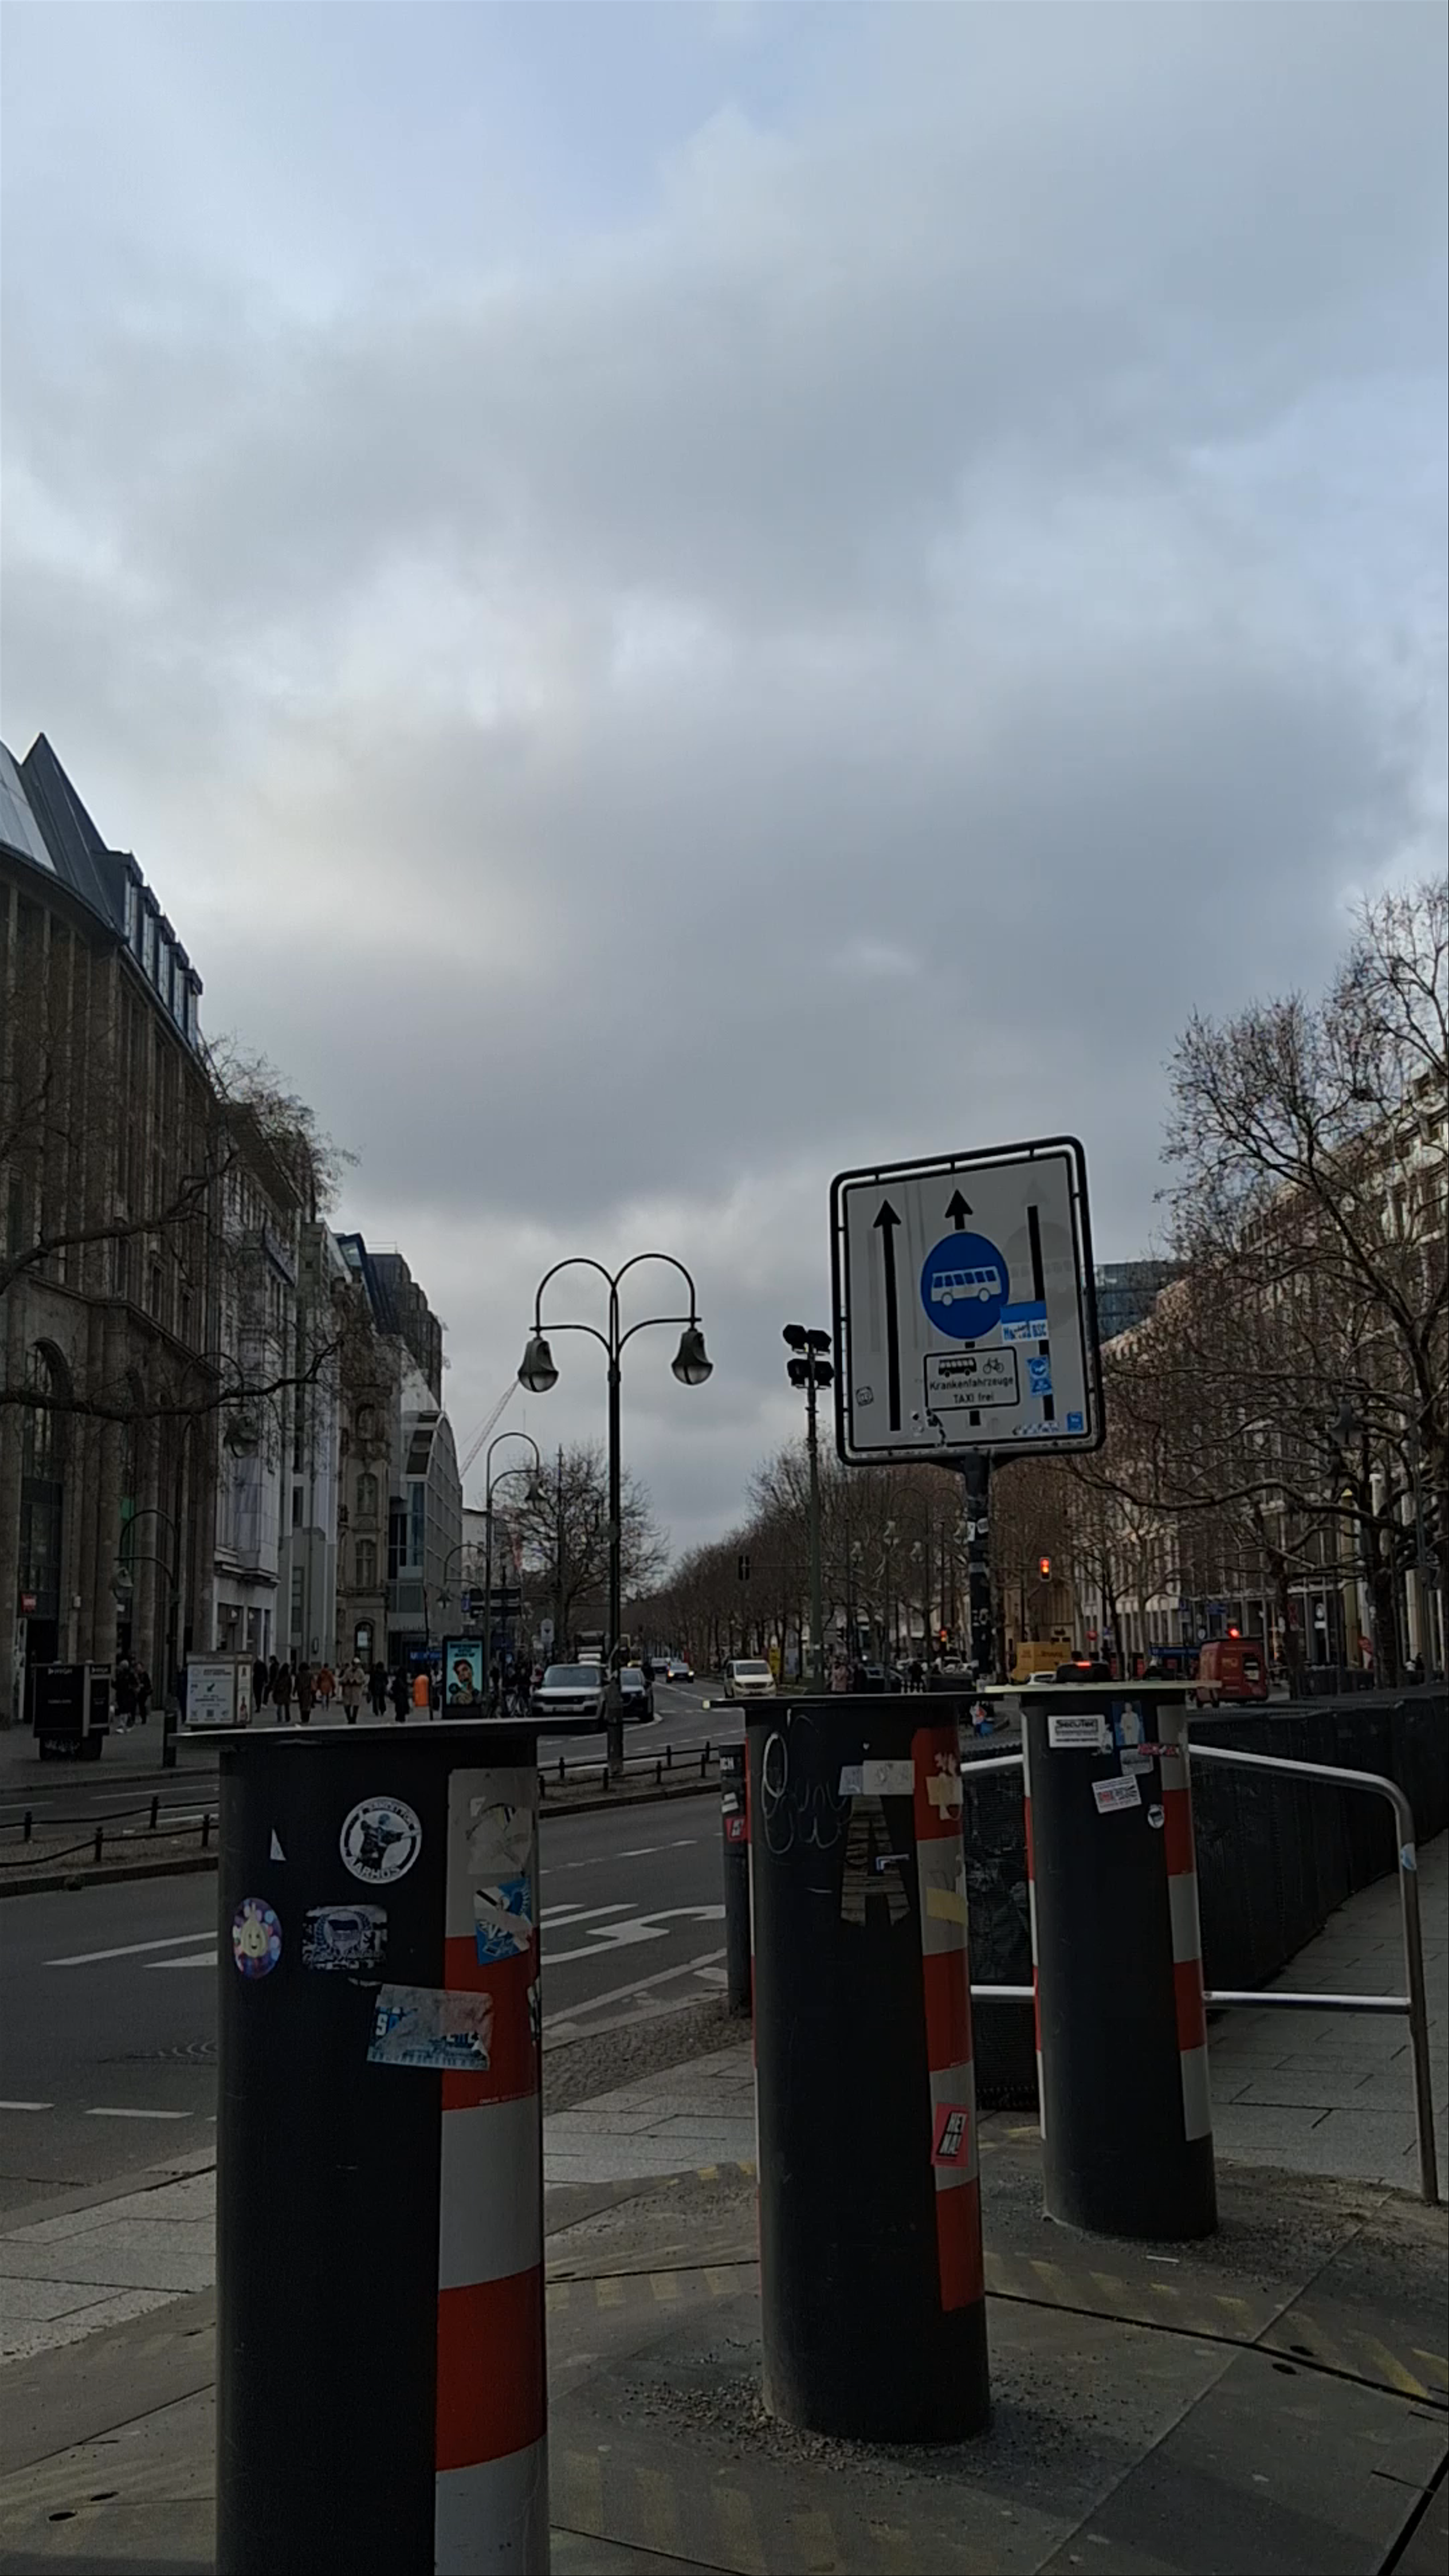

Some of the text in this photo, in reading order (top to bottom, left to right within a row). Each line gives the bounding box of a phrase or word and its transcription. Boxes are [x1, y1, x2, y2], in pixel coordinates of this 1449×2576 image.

[930, 1377, 1013, 1390] Krankenfahrzeuge
[953, 1392, 994, 1403] TAXI frei
